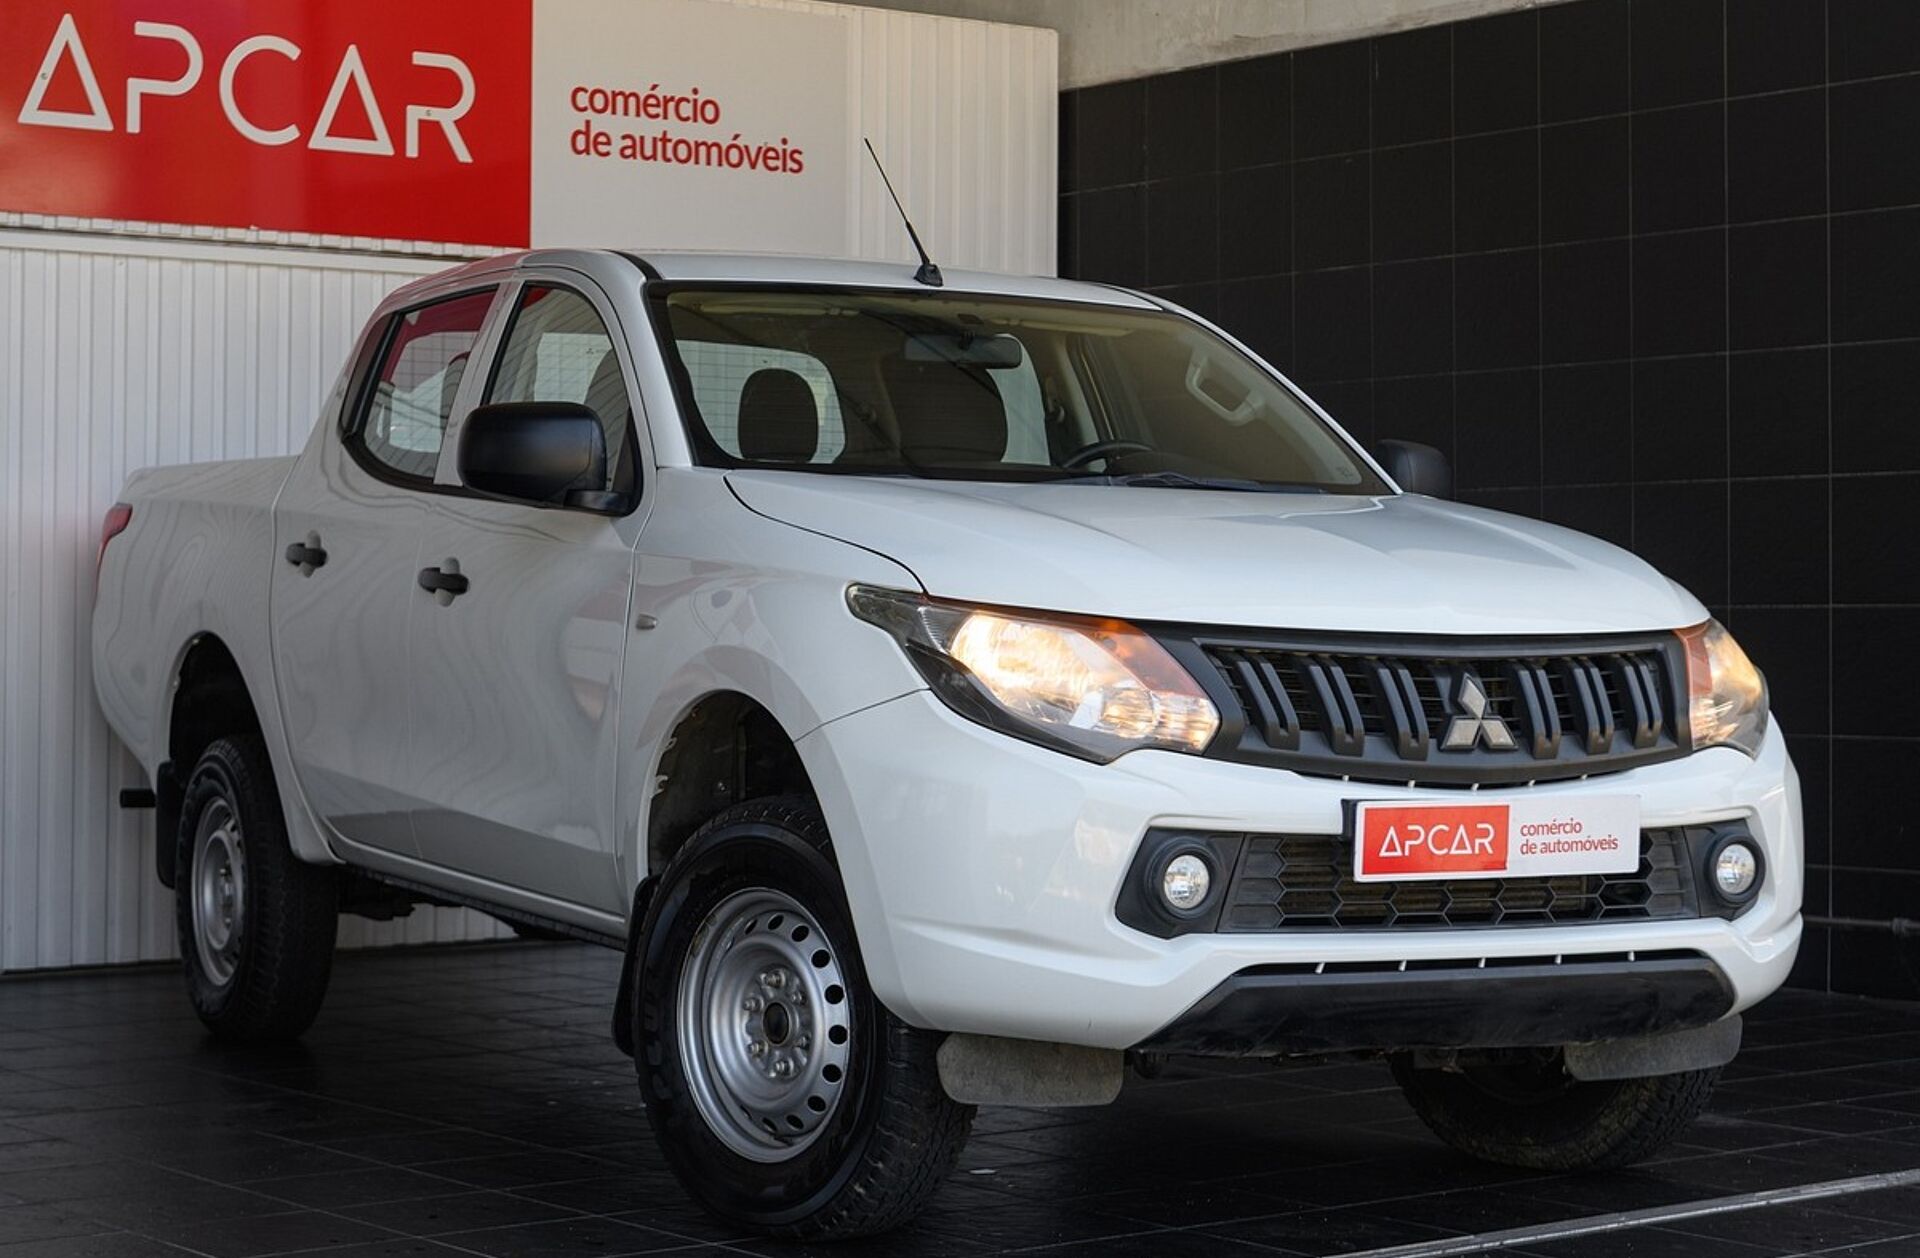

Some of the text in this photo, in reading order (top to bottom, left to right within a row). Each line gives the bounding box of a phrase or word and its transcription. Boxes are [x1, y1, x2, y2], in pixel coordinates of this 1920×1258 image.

[17, 13, 476, 163] APCAR
[570, 84, 720, 125] comércio
[570, 119, 804, 174] de automóveis
[1378, 823, 1495, 857] APCAR
[1520, 817, 1583, 837] comércio
[1520, 833, 1619, 855] de automóveis
